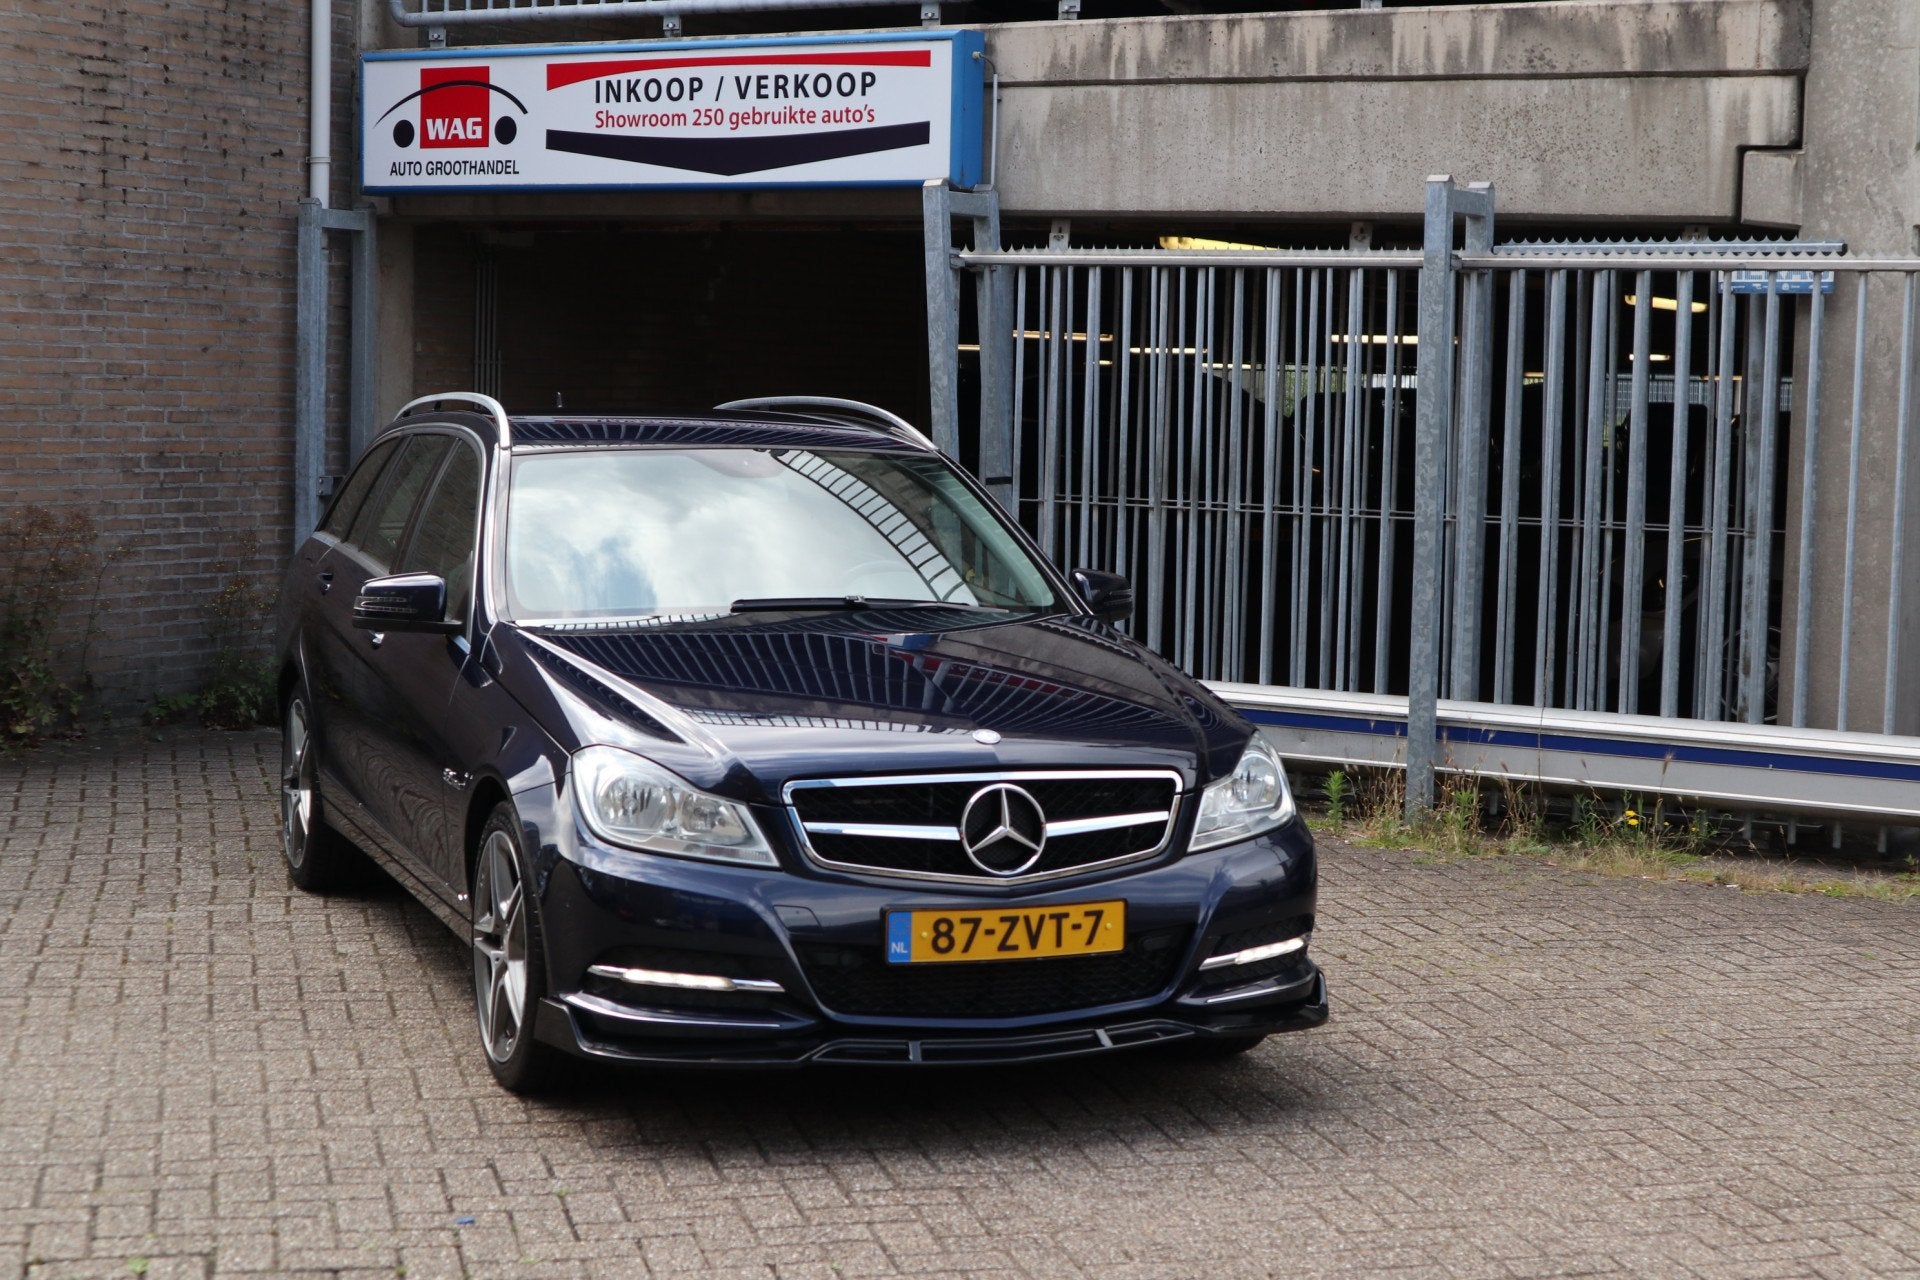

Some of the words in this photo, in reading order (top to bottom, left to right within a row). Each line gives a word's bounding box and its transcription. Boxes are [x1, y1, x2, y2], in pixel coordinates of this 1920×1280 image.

[595, 76, 704, 104] INKOOP
[714, 75, 725, 102] /
[734, 71, 877, 100] VERKOOP
[425, 116, 483, 140] WAG
[594, 109, 687, 129] Showroom
[692, 108, 725, 127] 250
[728, 105, 817, 131] gebruikte
[821, 104, 875, 124] auto's
[389, 160, 422, 176] AUTO
[425, 159, 520, 176] GROOTHANDEL
[931, 909, 1105, 955] 87-ZVT-7
[890, 942, 909, 954] NL
